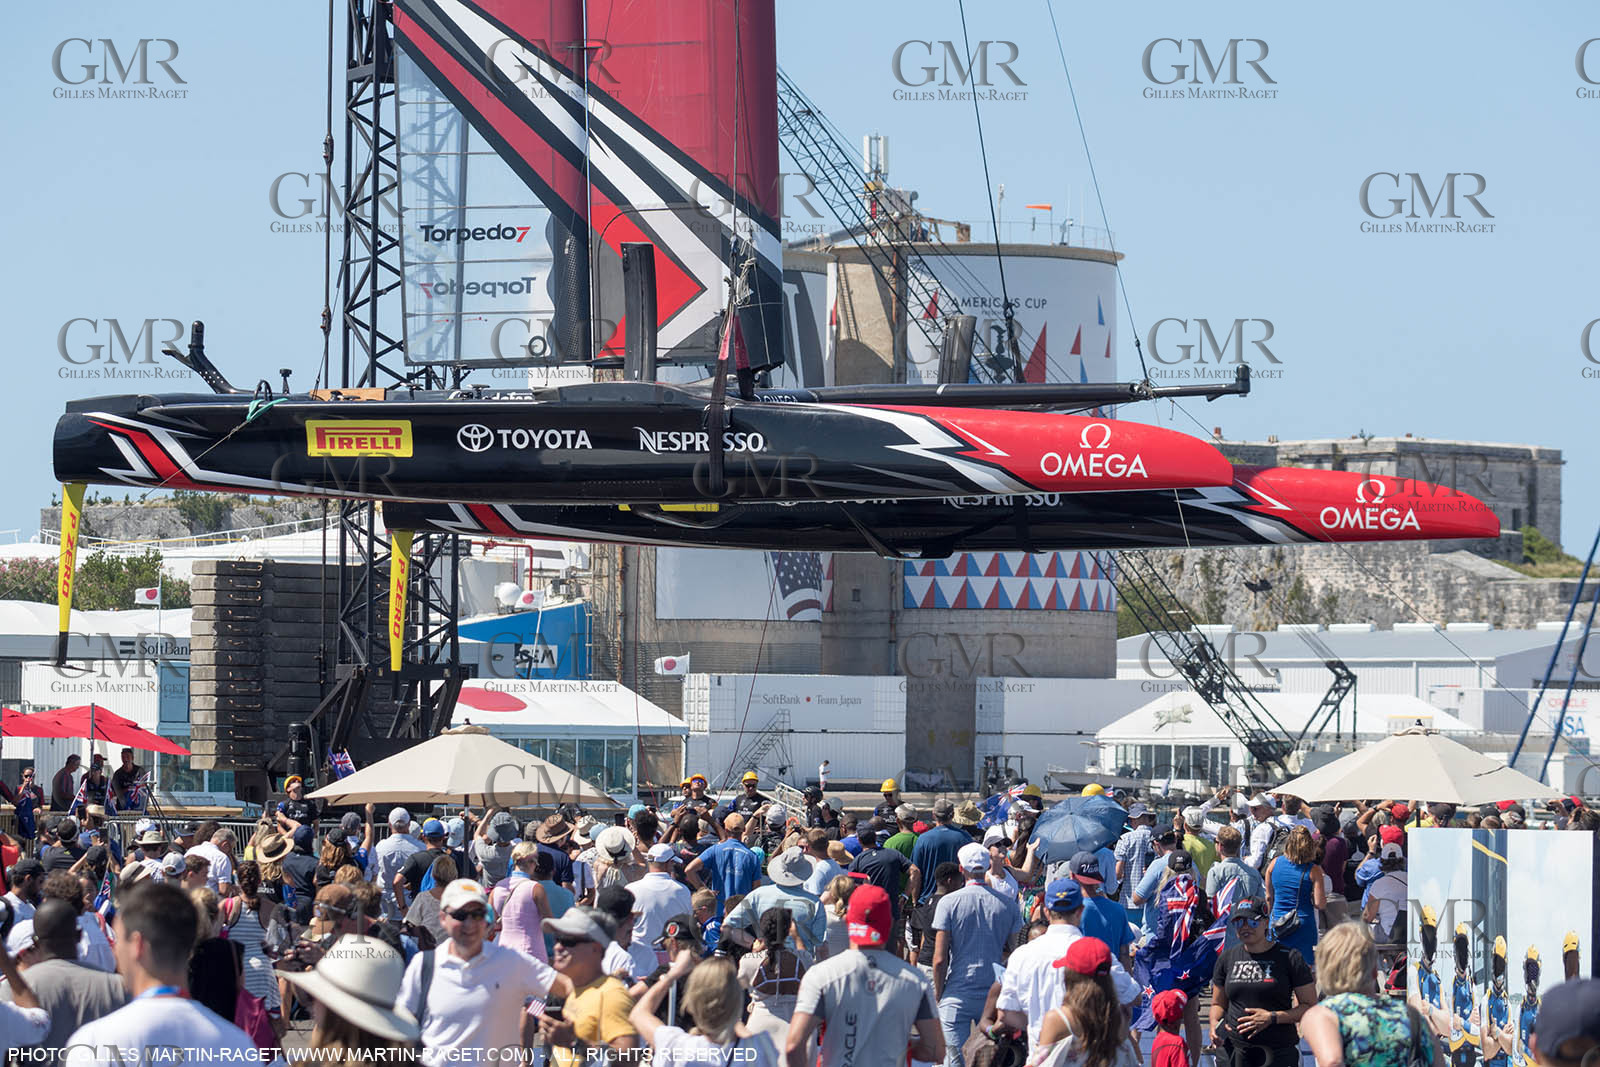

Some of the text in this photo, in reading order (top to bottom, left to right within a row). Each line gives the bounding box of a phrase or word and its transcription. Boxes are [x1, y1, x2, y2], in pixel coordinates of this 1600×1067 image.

[420, 223, 531, 245] Torpedo7
[1025, 298, 1047, 309] CUP
[315, 427, 402, 450] PIRELLI
[497, 429, 593, 449] TOYOTA
[1040, 452, 1148, 478] OMEGA
[1320, 507, 1421, 531] OMEGA
[62, 511, 77, 598] P ZERO
[393, 558, 406, 639] P ZERO
[762, 694, 862, 707] SoftBank Team Japan
[1231, 964, 1263, 979] USA
